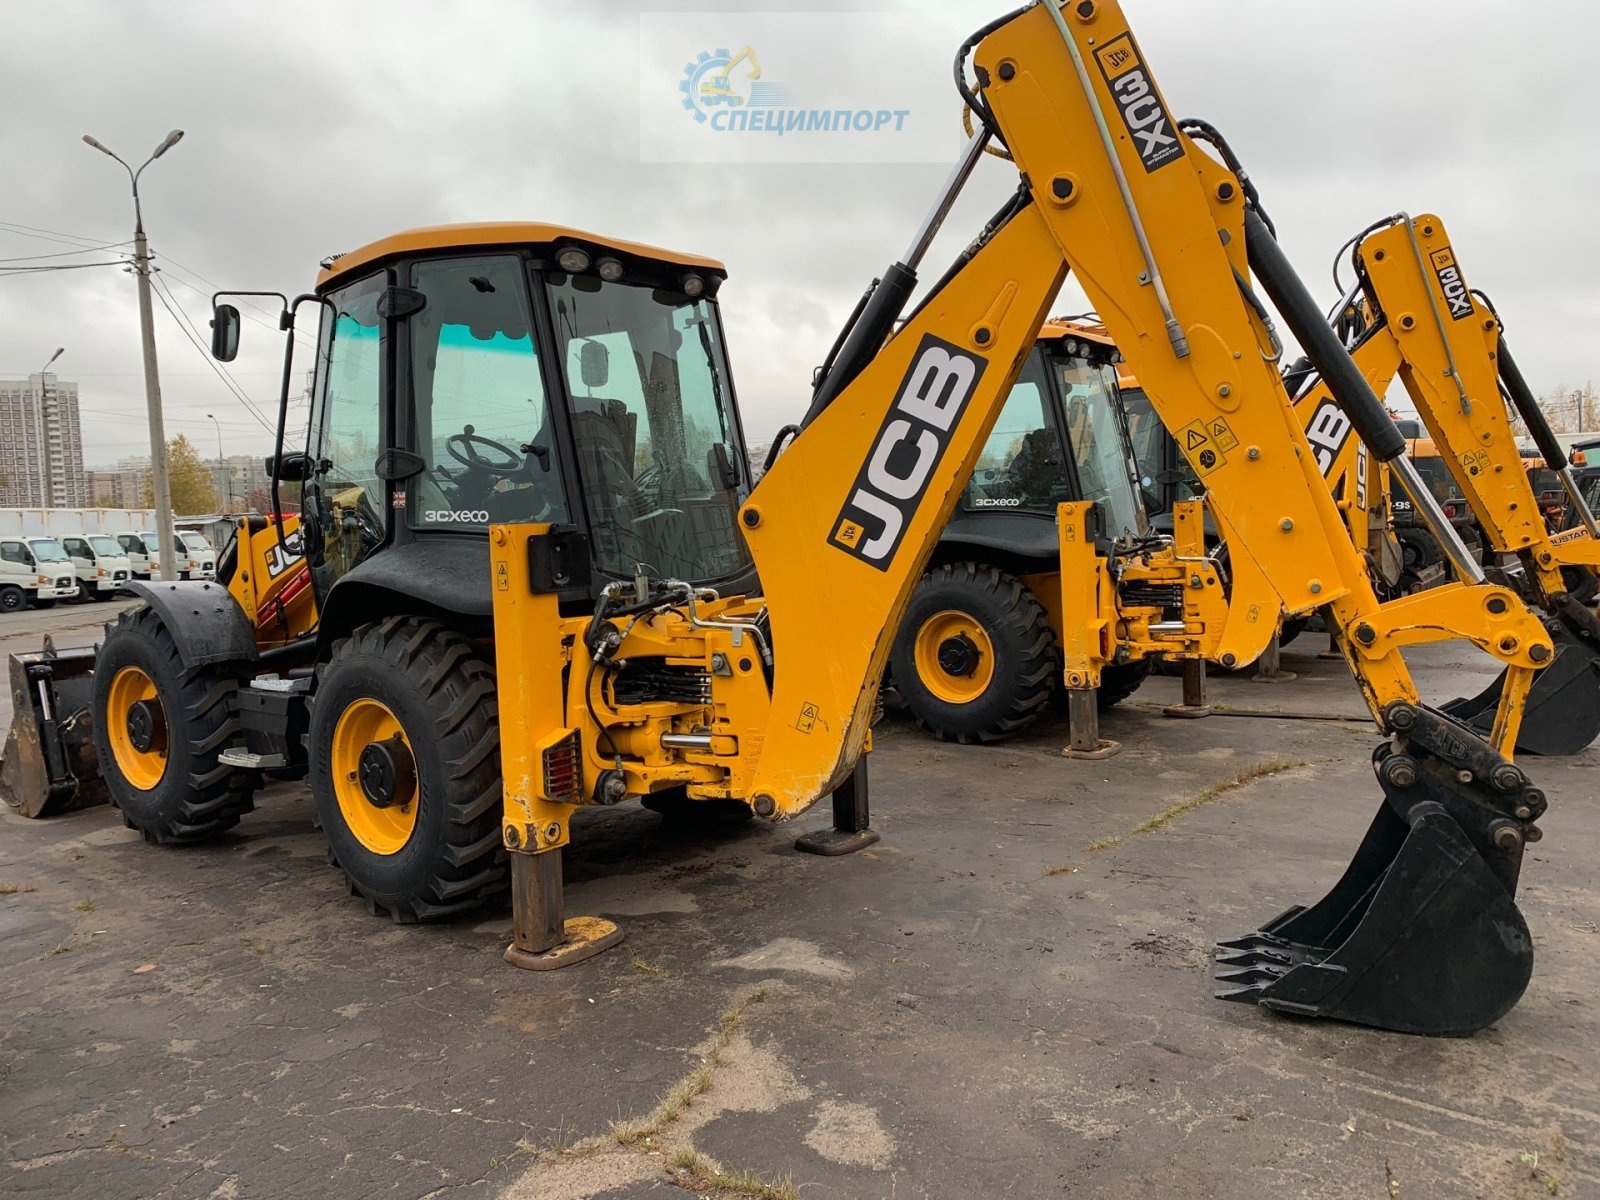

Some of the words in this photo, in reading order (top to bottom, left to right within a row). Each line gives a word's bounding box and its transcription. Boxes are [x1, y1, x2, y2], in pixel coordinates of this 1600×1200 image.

[1108, 49, 1129, 67] JCB
[1114, 70, 1176, 158] 3CX
[1439, 266, 1471, 313] 3CX
[851, 346, 976, 560] JCB
[269, 533, 304, 576] JC
[1550, 529, 1589, 545] USTAN
